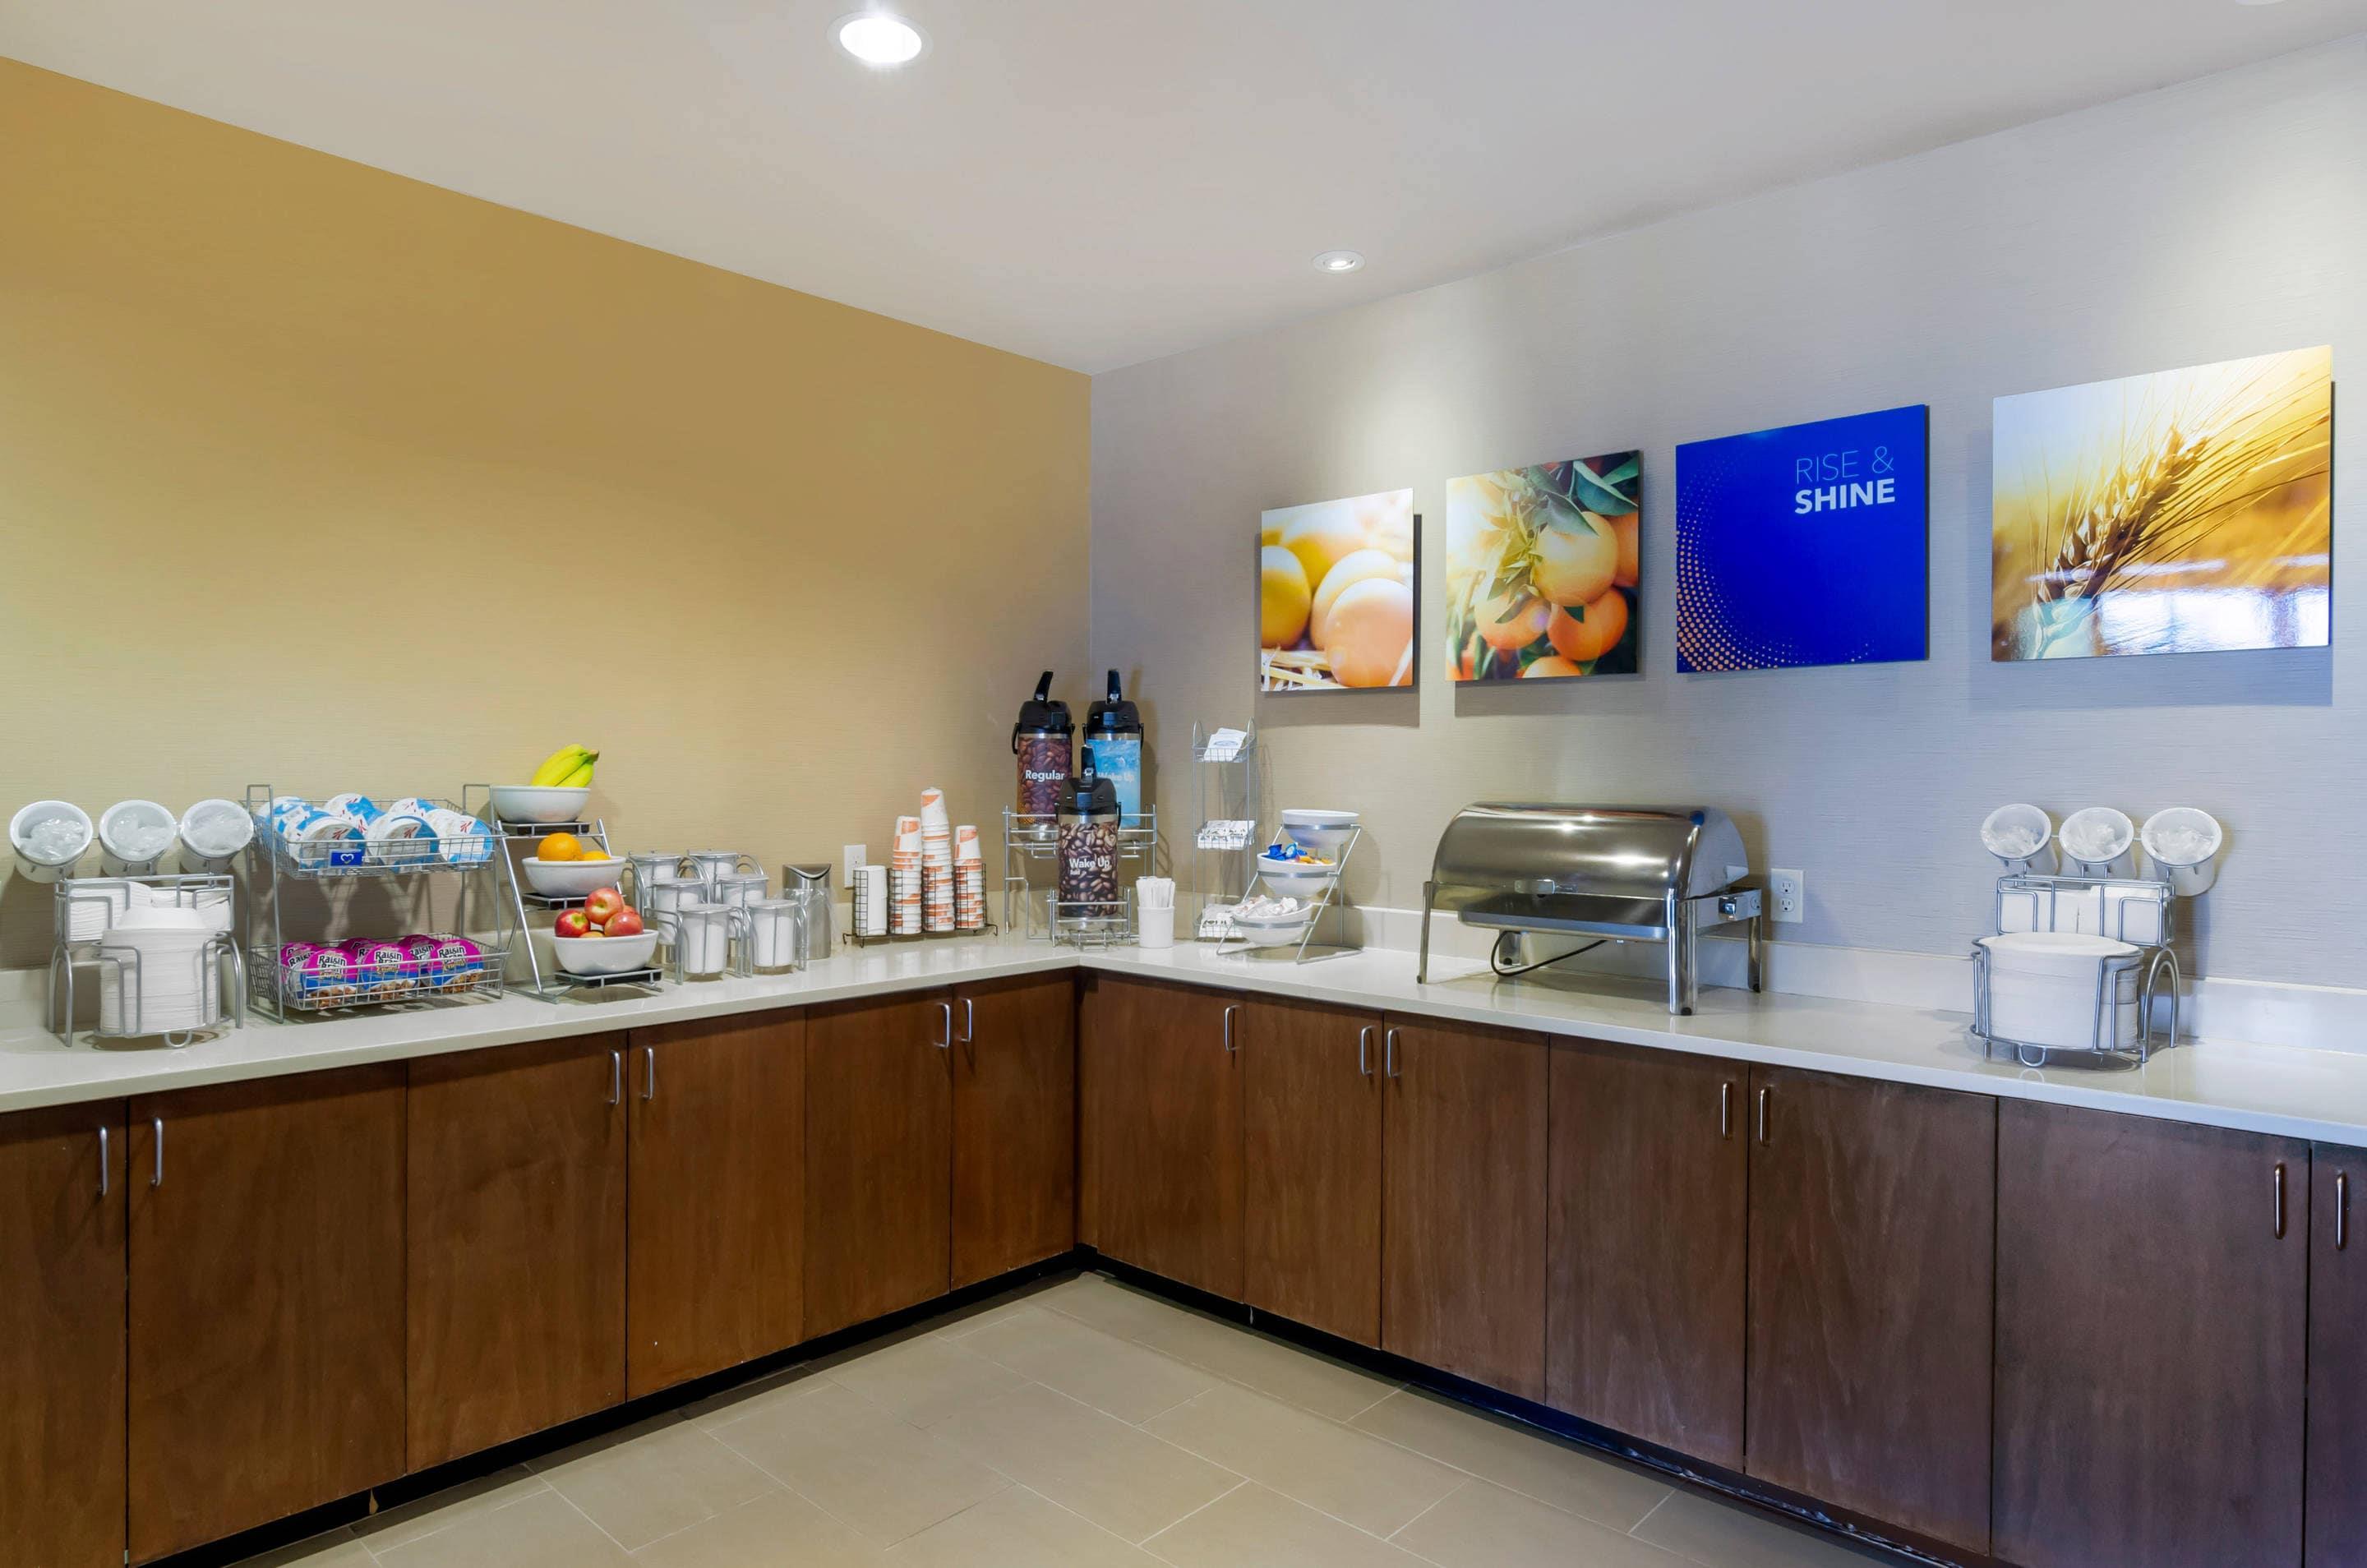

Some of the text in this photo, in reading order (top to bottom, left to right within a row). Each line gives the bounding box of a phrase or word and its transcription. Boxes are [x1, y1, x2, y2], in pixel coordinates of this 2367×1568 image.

[1796, 445, 1894, 485] RISE &
[1794, 477, 1896, 514] SHINE
[1025, 769, 1066, 782] Regular
[1069, 857, 1110, 869] Wake Up
[375, 951, 402, 961] Raisin
[438, 946, 465, 958] Raisin
[318, 955, 346, 966] Raisin
